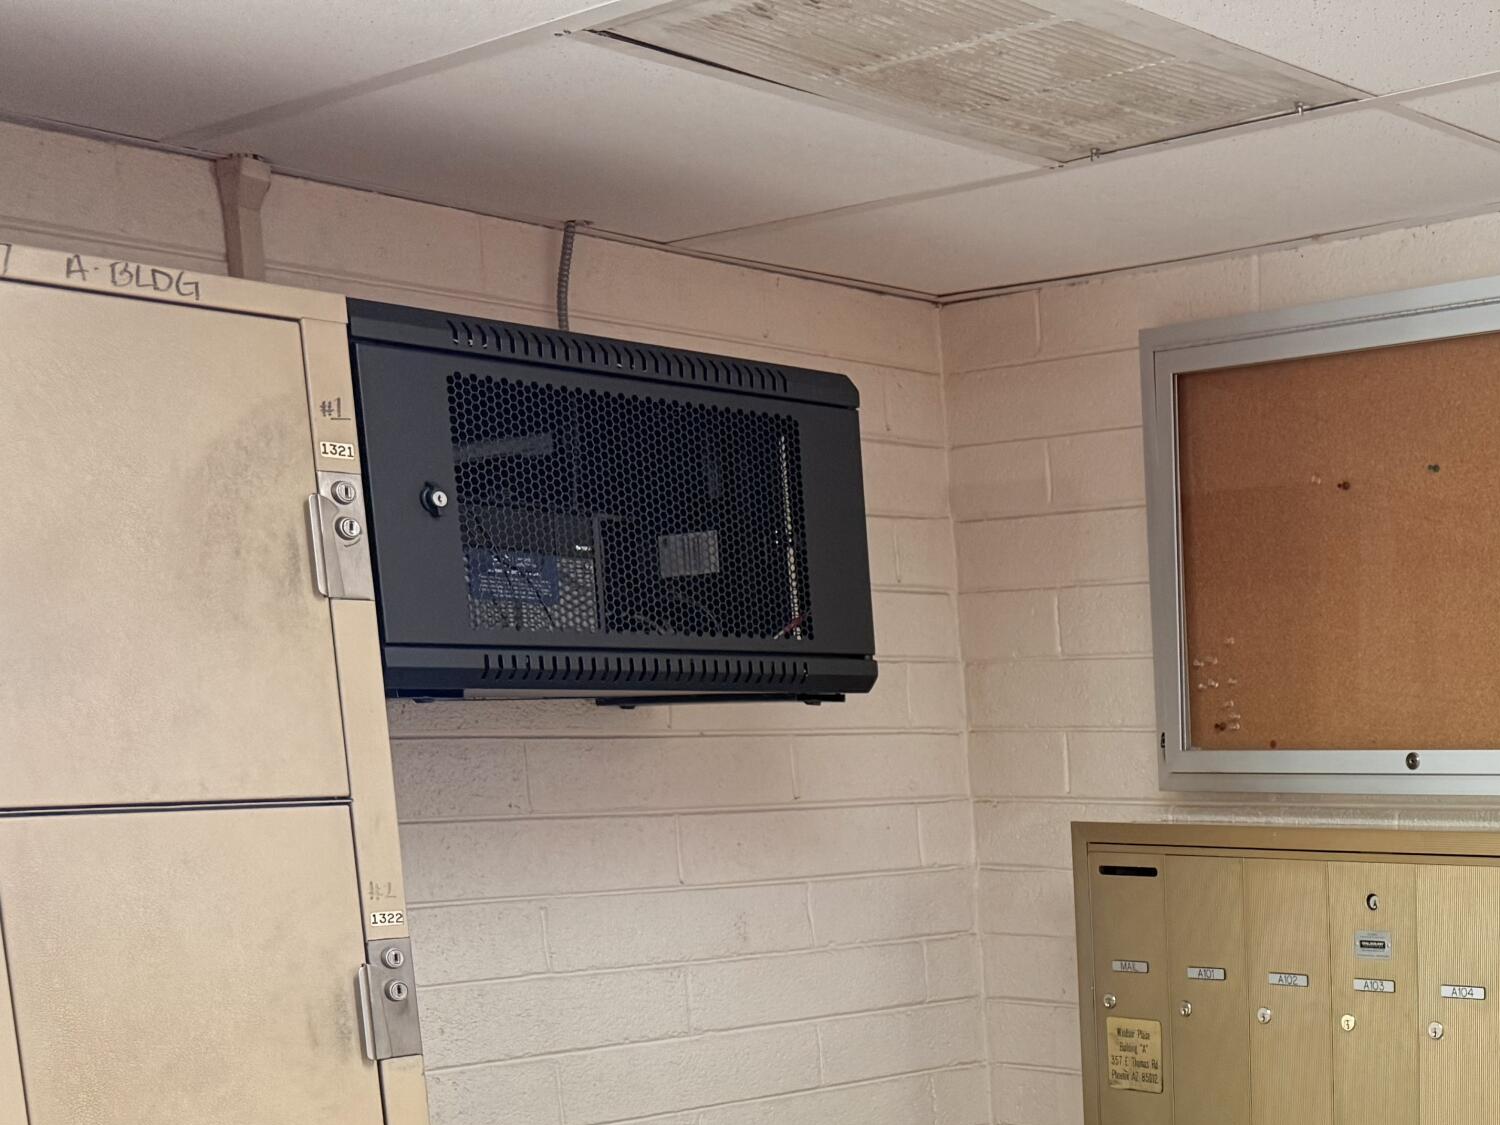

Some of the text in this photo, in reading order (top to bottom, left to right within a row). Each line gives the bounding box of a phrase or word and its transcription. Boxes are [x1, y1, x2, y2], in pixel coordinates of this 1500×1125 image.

[111, 261, 200, 300] BLDG
[321, 442, 354, 458] 1321
[371, 913, 404, 925] 1322
[1197, 968, 1215, 979] A101
[1278, 975, 1298, 986] A102
[1363, 980, 1385, 991] A103
[1451, 987, 1474, 998] A104
[1111, 1055, 1122, 1065] 357
[1125, 1056, 1128, 1066] E
[1131, 1057, 1149, 1068] Thomas
